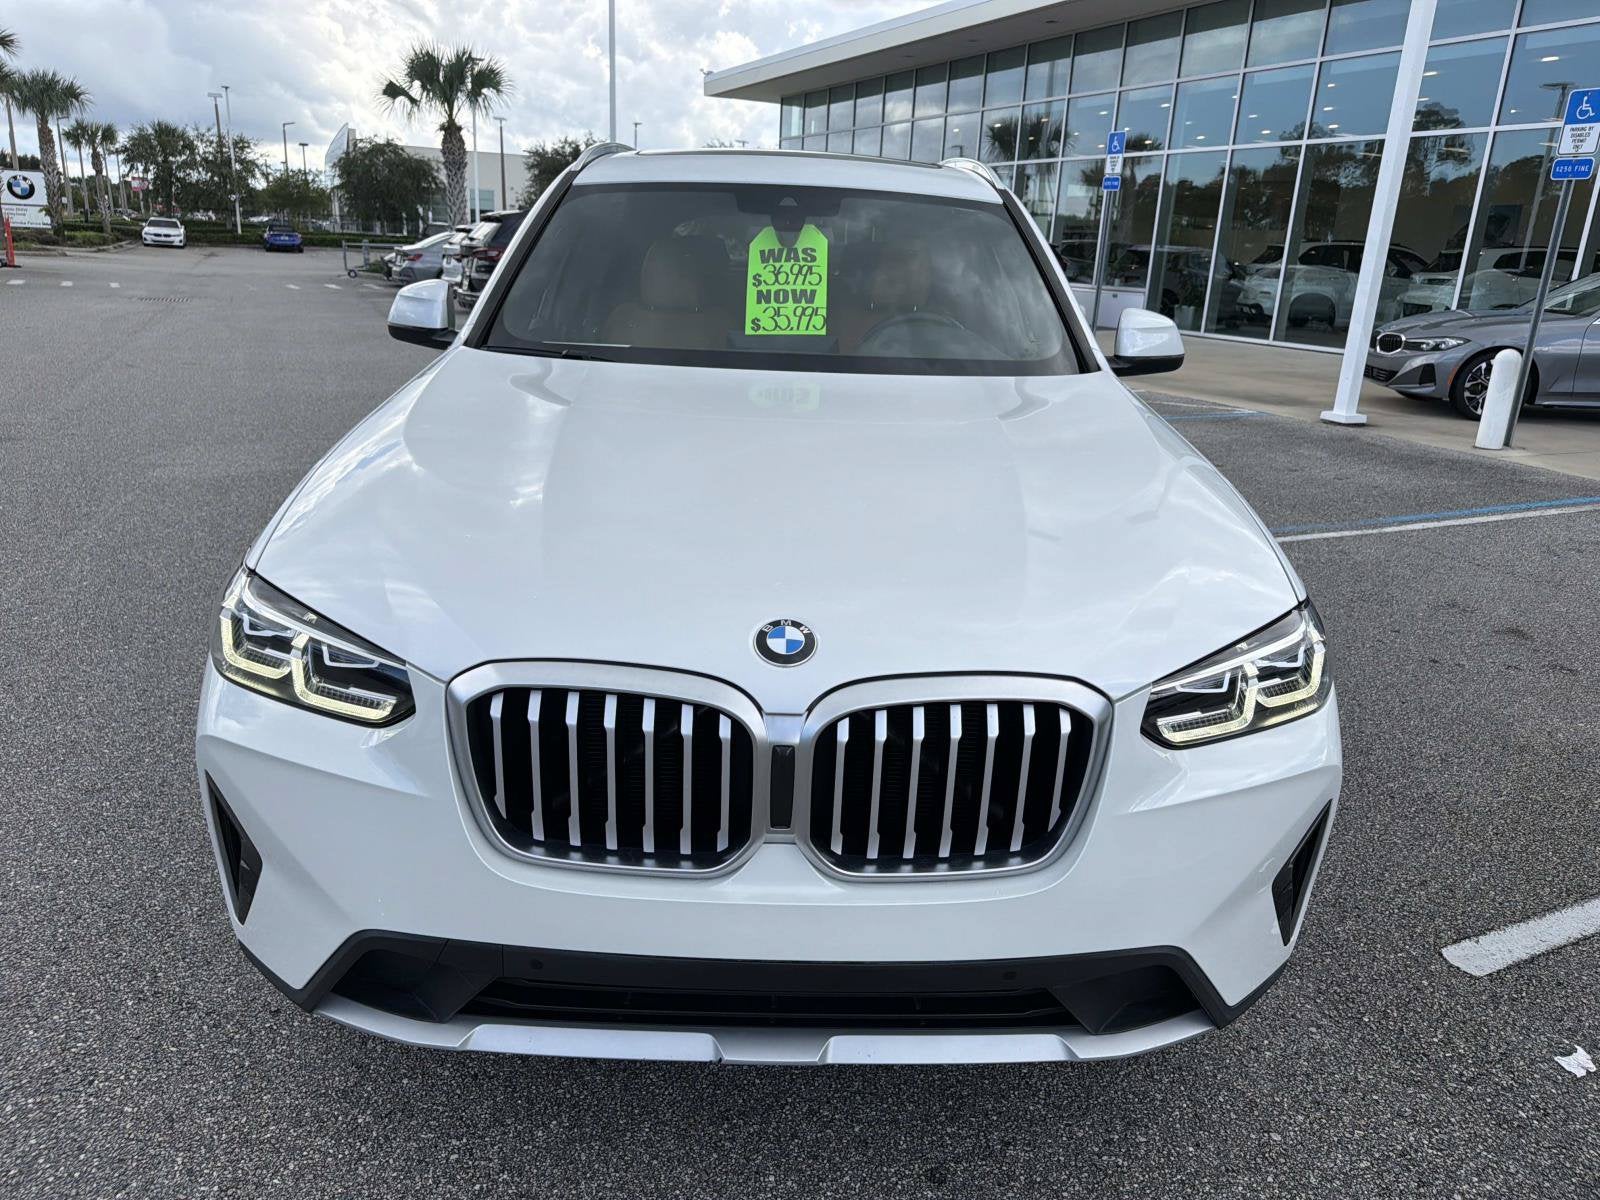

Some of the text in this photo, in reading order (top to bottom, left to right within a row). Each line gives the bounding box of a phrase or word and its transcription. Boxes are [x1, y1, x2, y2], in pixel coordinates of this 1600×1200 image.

[759, 247, 817, 264] WAS
[756, 289, 817, 304] NOW
[760, 619, 812, 634] BMW
